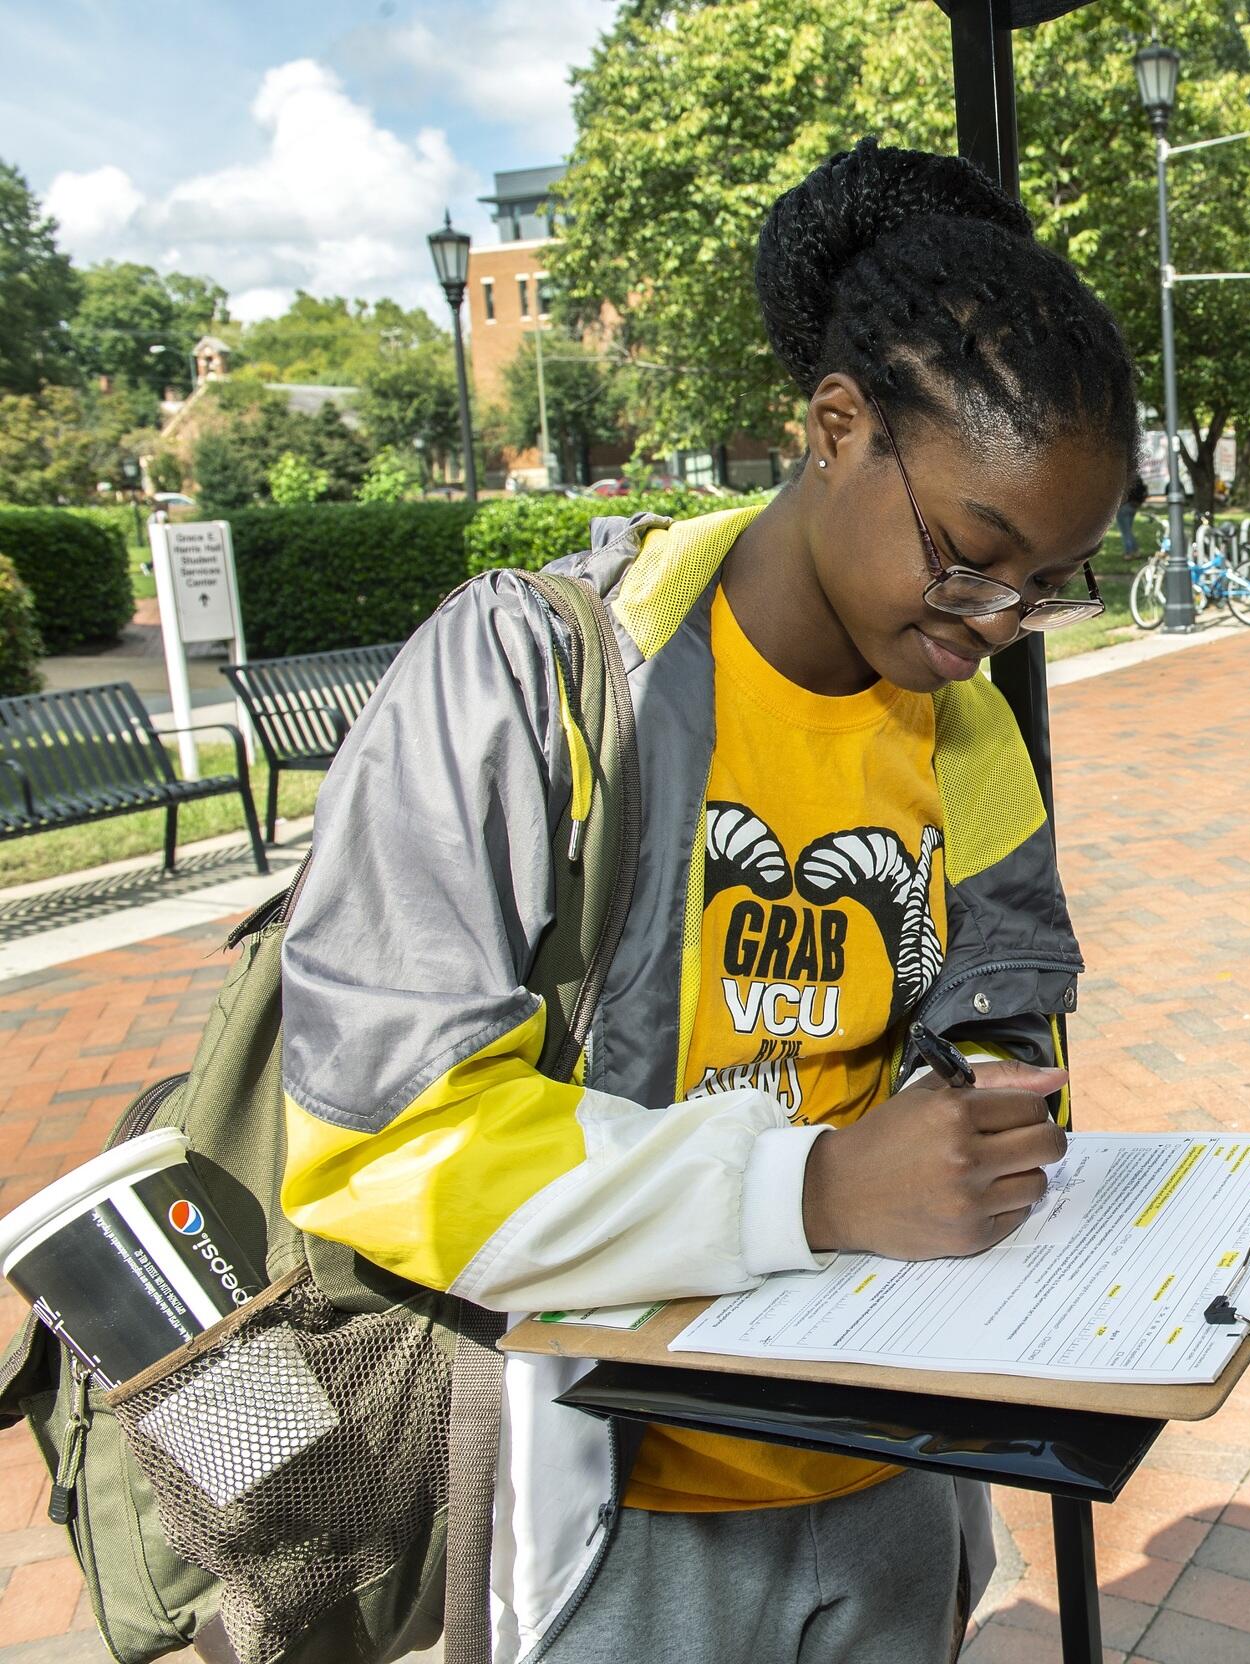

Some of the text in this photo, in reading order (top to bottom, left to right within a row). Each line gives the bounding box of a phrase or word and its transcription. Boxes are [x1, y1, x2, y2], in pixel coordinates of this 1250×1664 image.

[181, 556, 217, 565] Student
[181, 567, 221, 576] Services
[186, 579, 217, 588] Center
[723, 900, 848, 982] GRAB
[721, 978, 841, 1037] VCU
[754, 1039, 803, 1063] BY THE
[191, 1233, 255, 1309] pepsi
[886, 1272, 901, 1283] Privacy
[1106, 1285, 1122, 1297] Phone
[848, 1308, 872, 1329] information
[831, 1330, 851, 1346] provided
[1165, 1329, 1182, 1344] Gender
